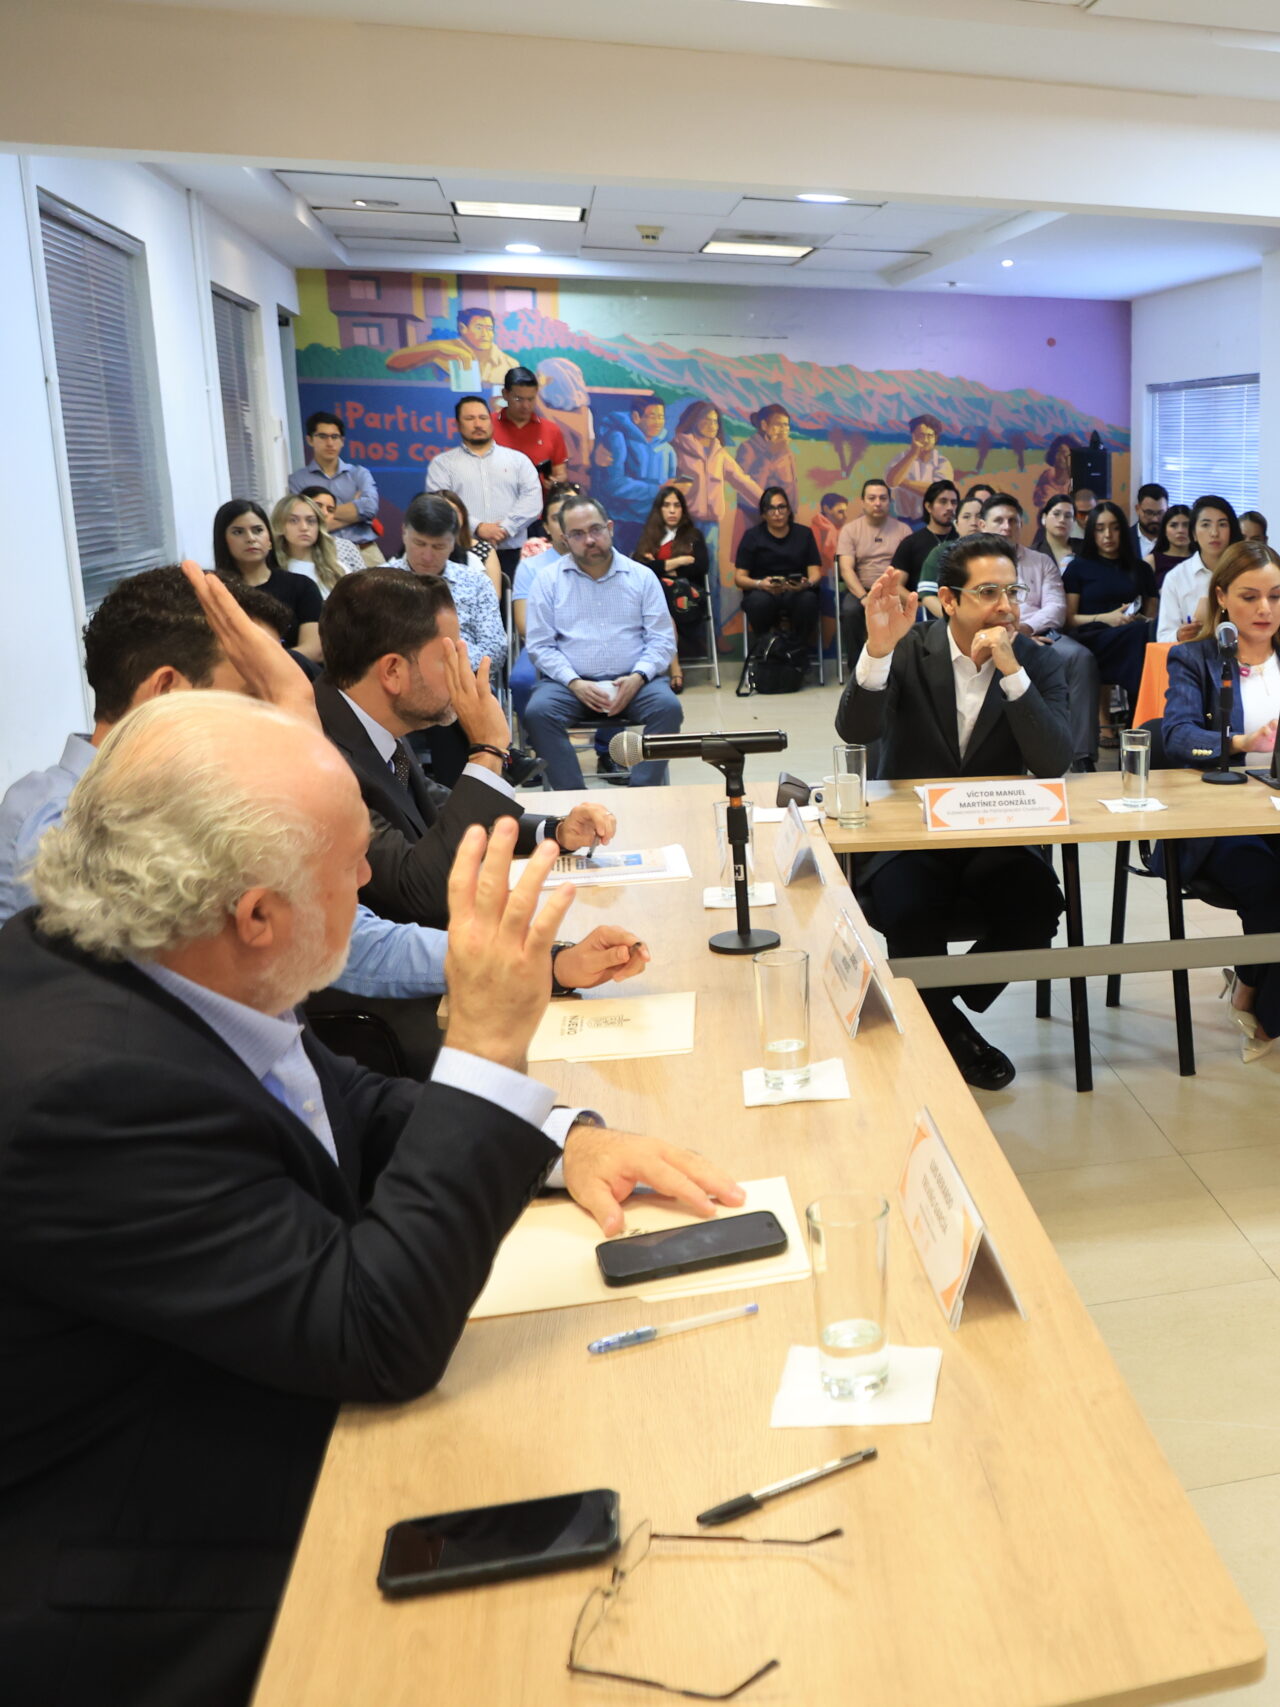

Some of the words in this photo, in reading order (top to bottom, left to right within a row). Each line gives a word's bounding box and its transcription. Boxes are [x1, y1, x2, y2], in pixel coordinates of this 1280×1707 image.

[335, 400, 461, 440] ¡Particip
[349, 440, 399, 461] nos
[408, 443, 453, 461] co
[966, 789, 994, 798] VÍCTOR
[959, 799, 997, 808] MARTÍNEZ
[998, 798, 1036, 807] GONZÁLES
